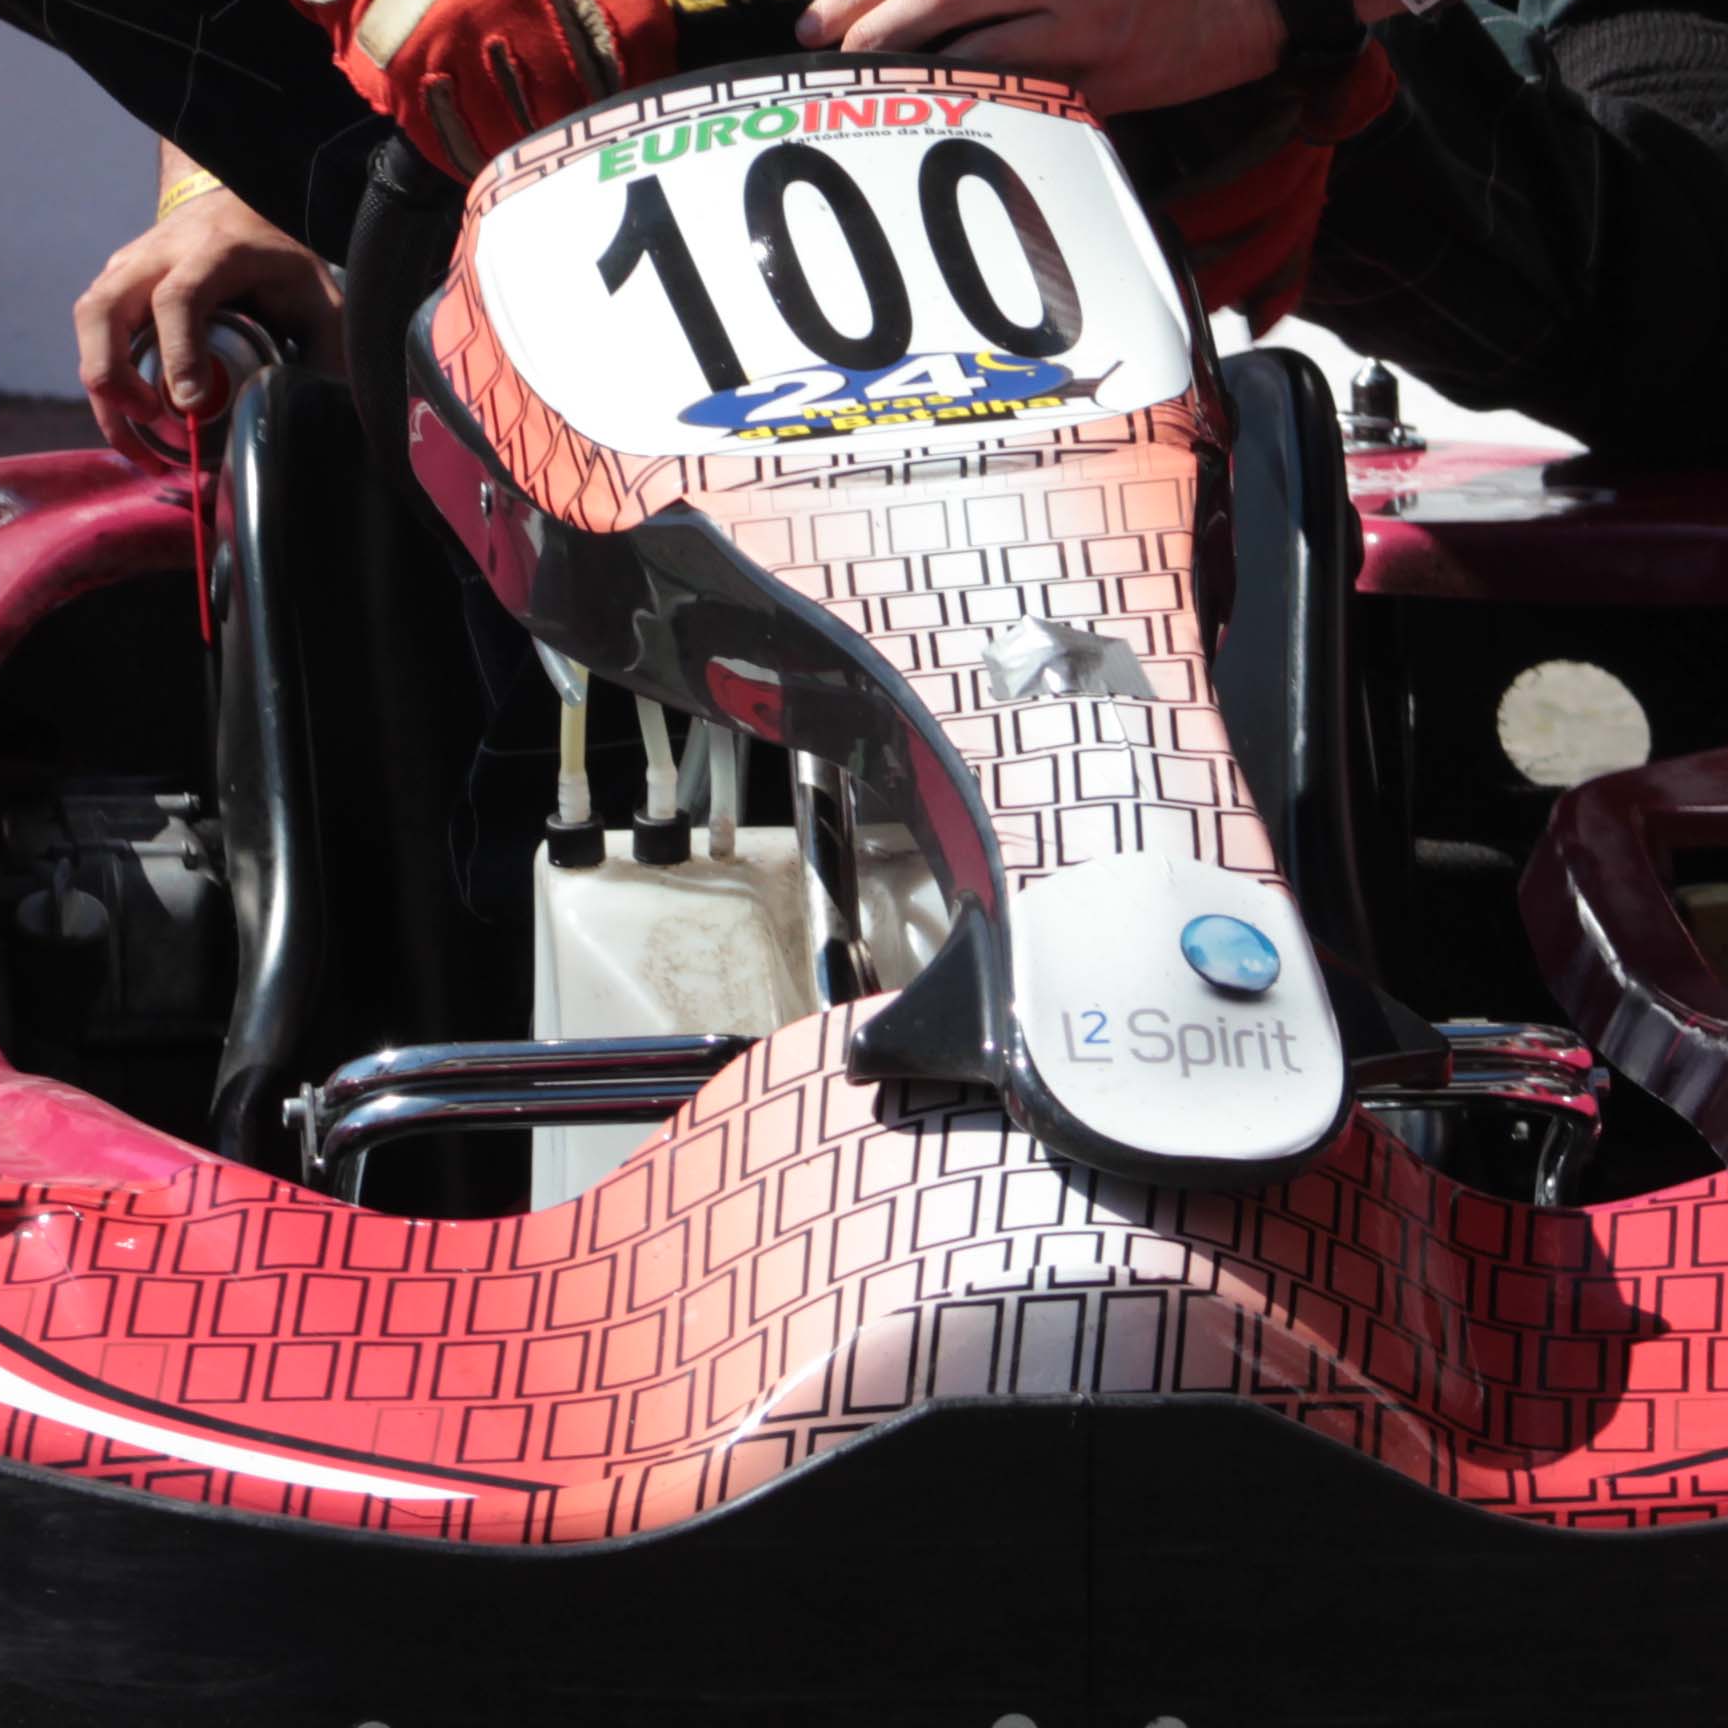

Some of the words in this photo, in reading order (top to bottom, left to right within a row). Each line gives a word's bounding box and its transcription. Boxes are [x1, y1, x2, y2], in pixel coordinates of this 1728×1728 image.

[596, 137, 1083, 392] 100
[735, 352, 988, 423] 24
[736, 425, 811, 440] da
[830, 396, 1063, 431] Batalha
[802, 394, 955, 420] horas
[1127, 1008, 1303, 1077] Spirit
